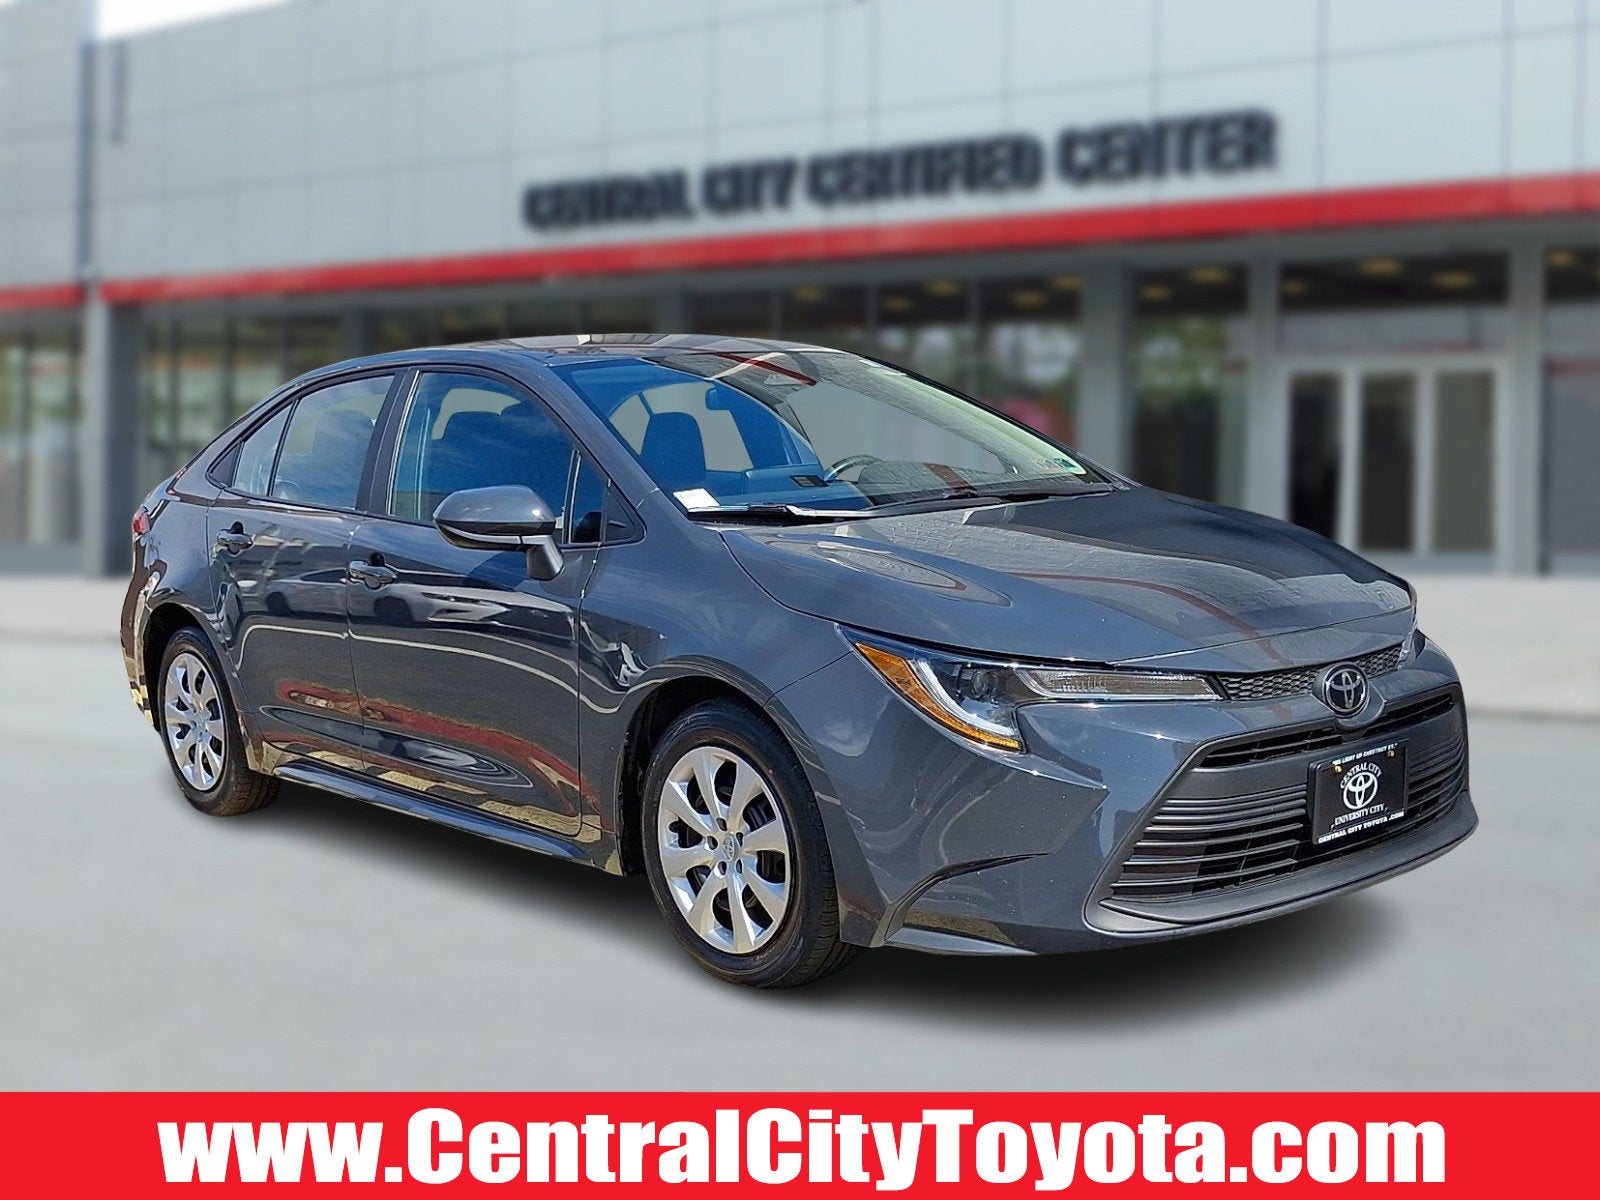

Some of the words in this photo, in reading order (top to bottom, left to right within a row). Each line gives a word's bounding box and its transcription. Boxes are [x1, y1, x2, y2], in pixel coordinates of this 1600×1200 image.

[524, 170, 695, 233] CENTRAL
[702, 160, 799, 217] CITY
[805, 136, 1045, 208] CERTIFIED
[1057, 111, 1277, 186] CENTER
[1340, 762, 1368, 789] CENTRAL
[1368, 762, 1383, 778] CITY
[1369, 803, 1385, 814] CITY
[1318, 830, 1347, 844] CENTRAL
[1347, 824, 1363, 834] CITY
